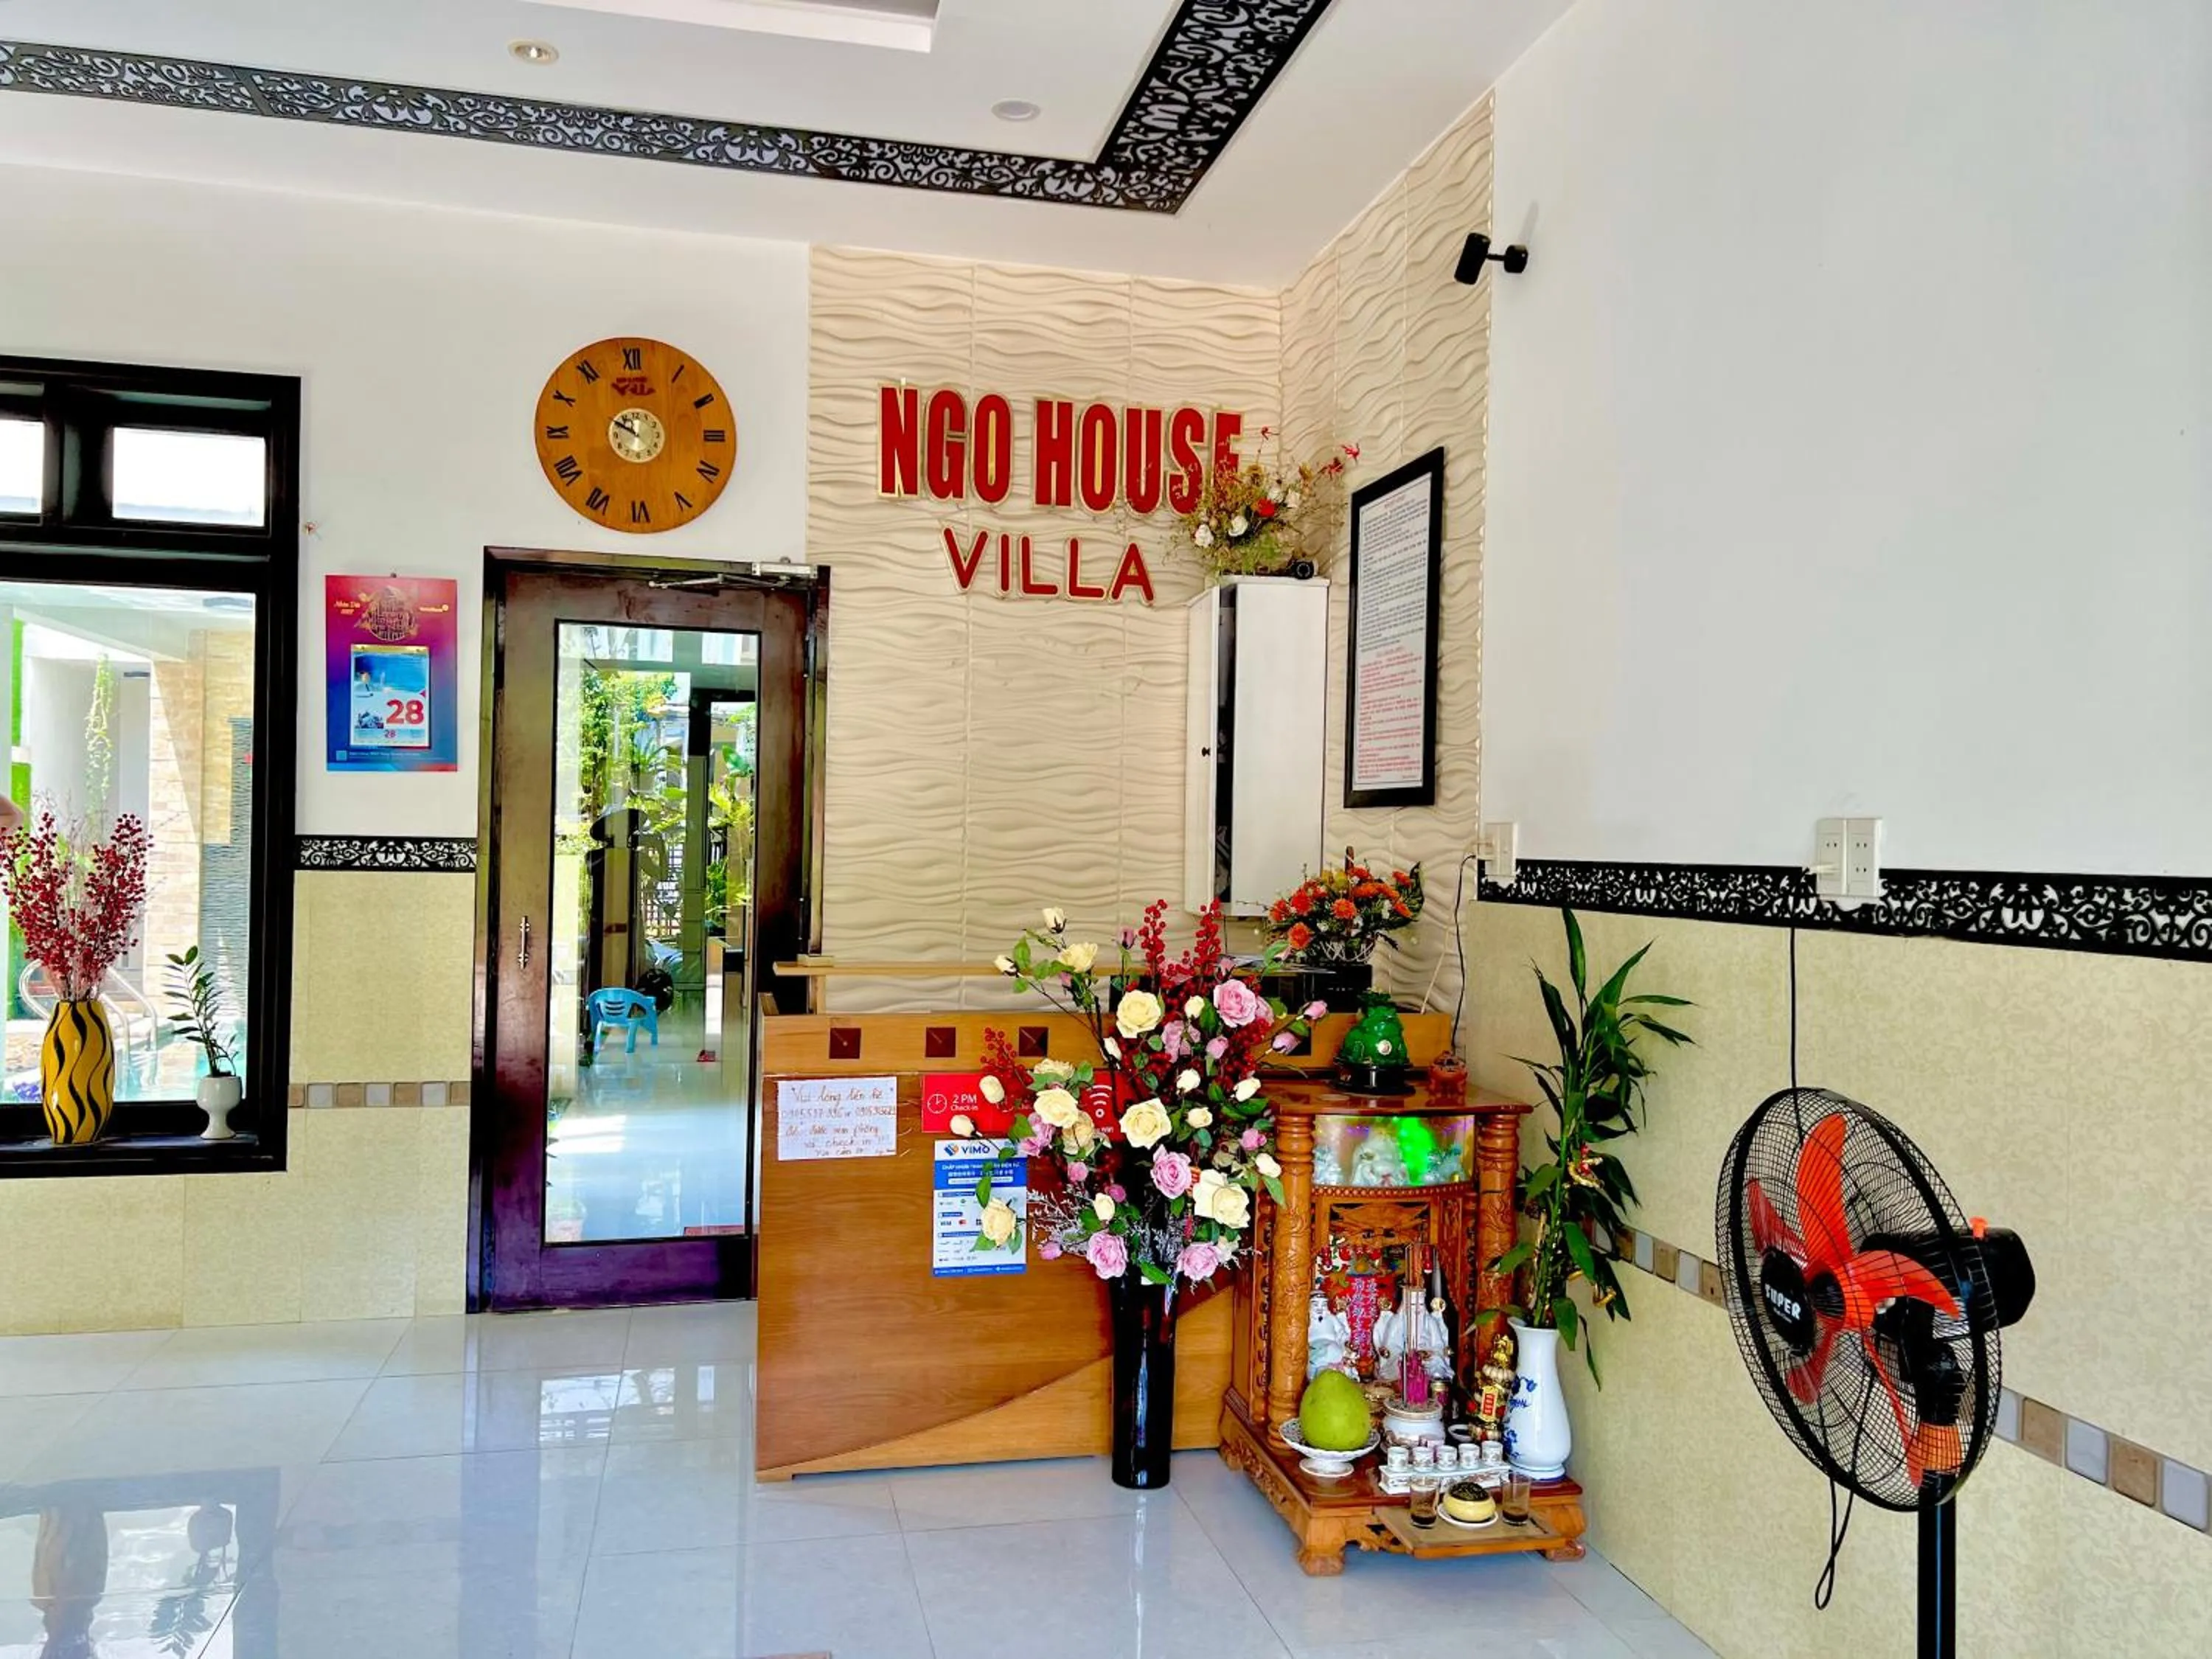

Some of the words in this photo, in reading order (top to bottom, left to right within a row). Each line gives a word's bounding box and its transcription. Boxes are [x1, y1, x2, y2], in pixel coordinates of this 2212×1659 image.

[623, 347, 641, 371] XII
[703, 430, 726, 442] III
[879, 383, 1012, 505] NGO
[1034, 399, 1244, 516] HOUSE
[942, 526, 1155, 603] VILLA
[386, 699, 424, 725] 28
[952, 1093, 959, 1104] 2
[961, 1093, 978, 1104] PM
